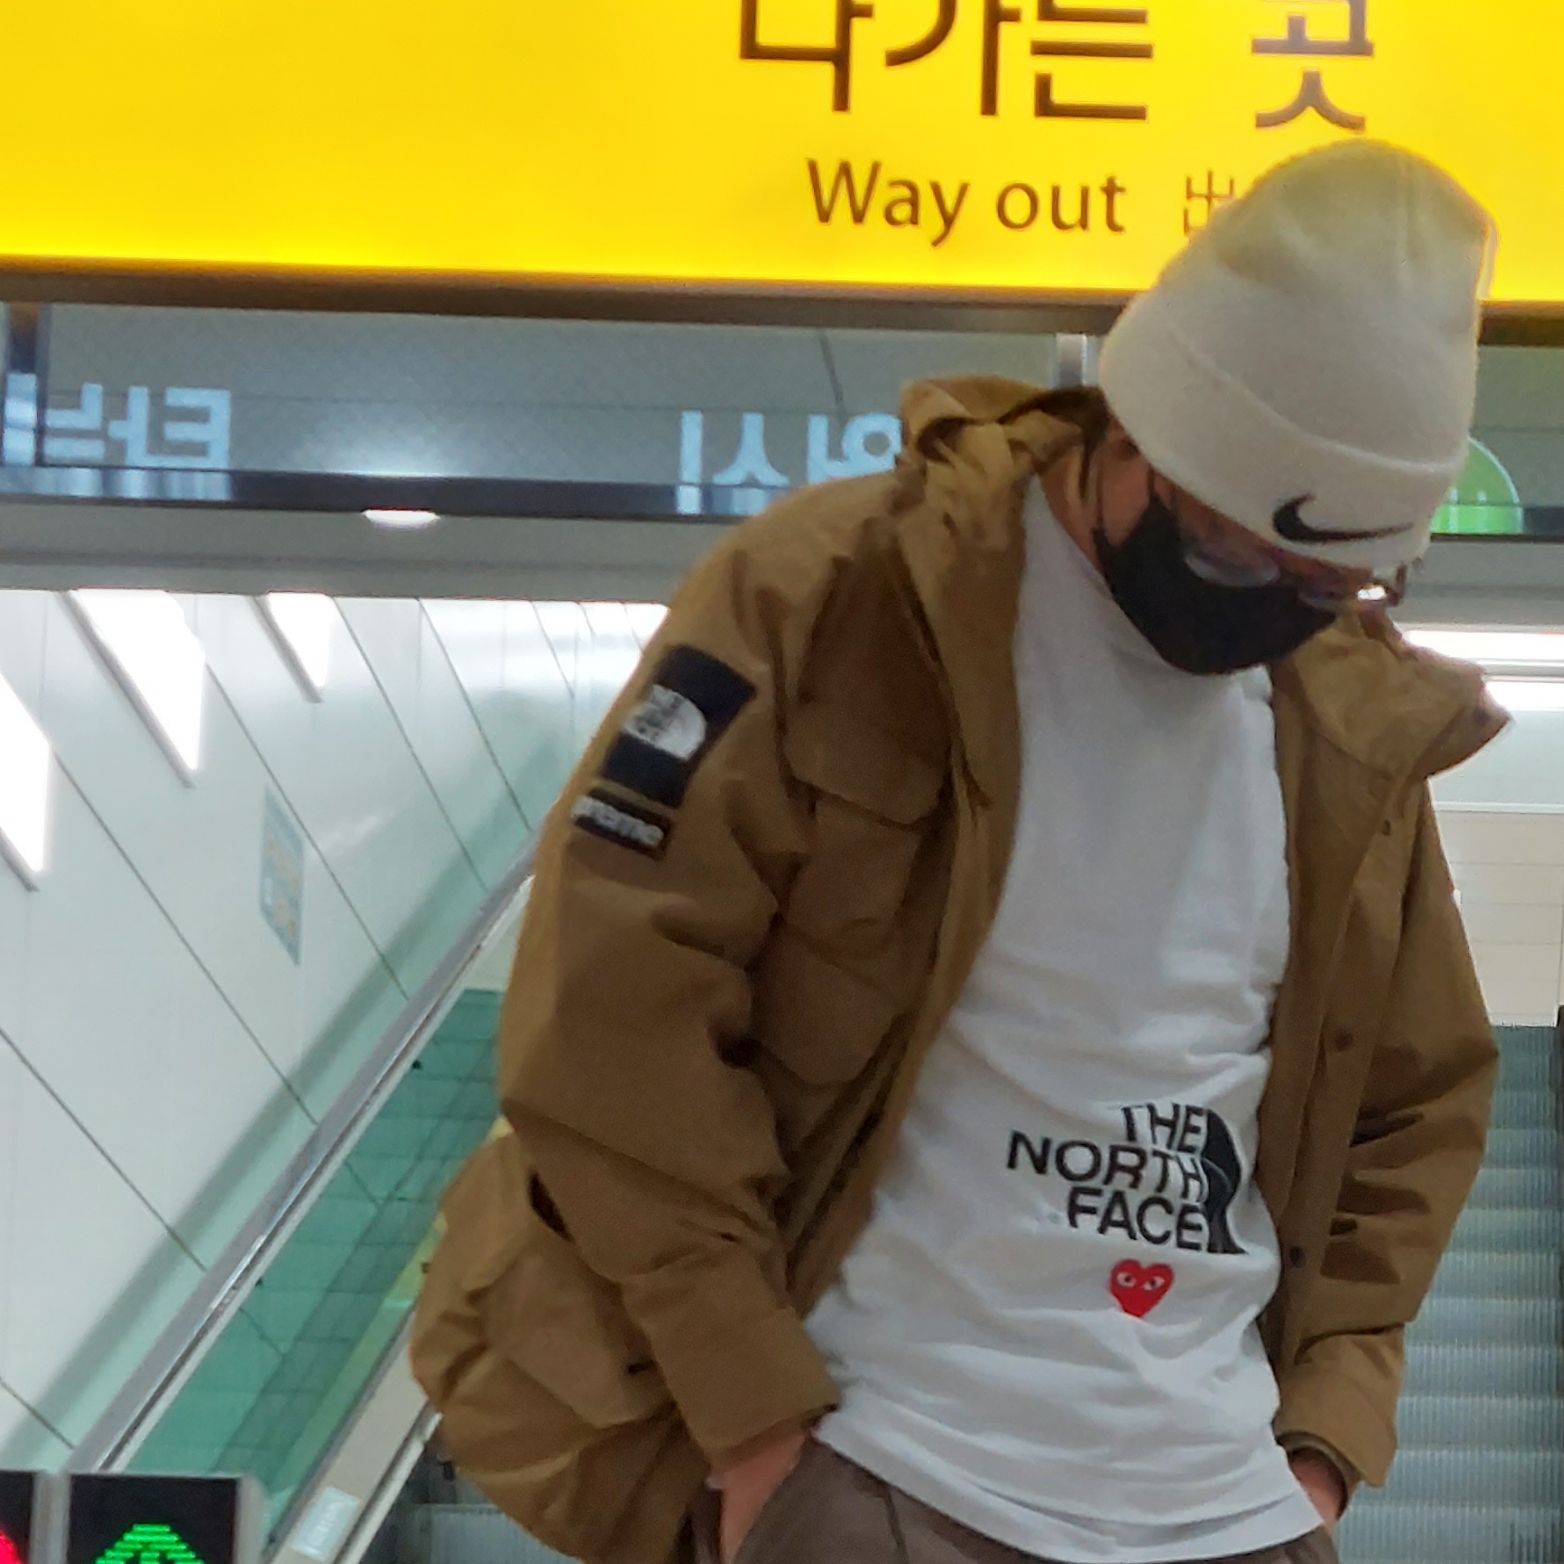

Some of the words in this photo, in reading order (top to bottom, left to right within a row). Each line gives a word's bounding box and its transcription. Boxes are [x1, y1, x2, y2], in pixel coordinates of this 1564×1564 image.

[806, 158, 970, 247] Way
[996, 174, 1127, 233] out
[1120, 1102, 1206, 1154] THE
[1006, 1129, 1207, 1202] NORTH
[1066, 1186, 1208, 1252] FACE
